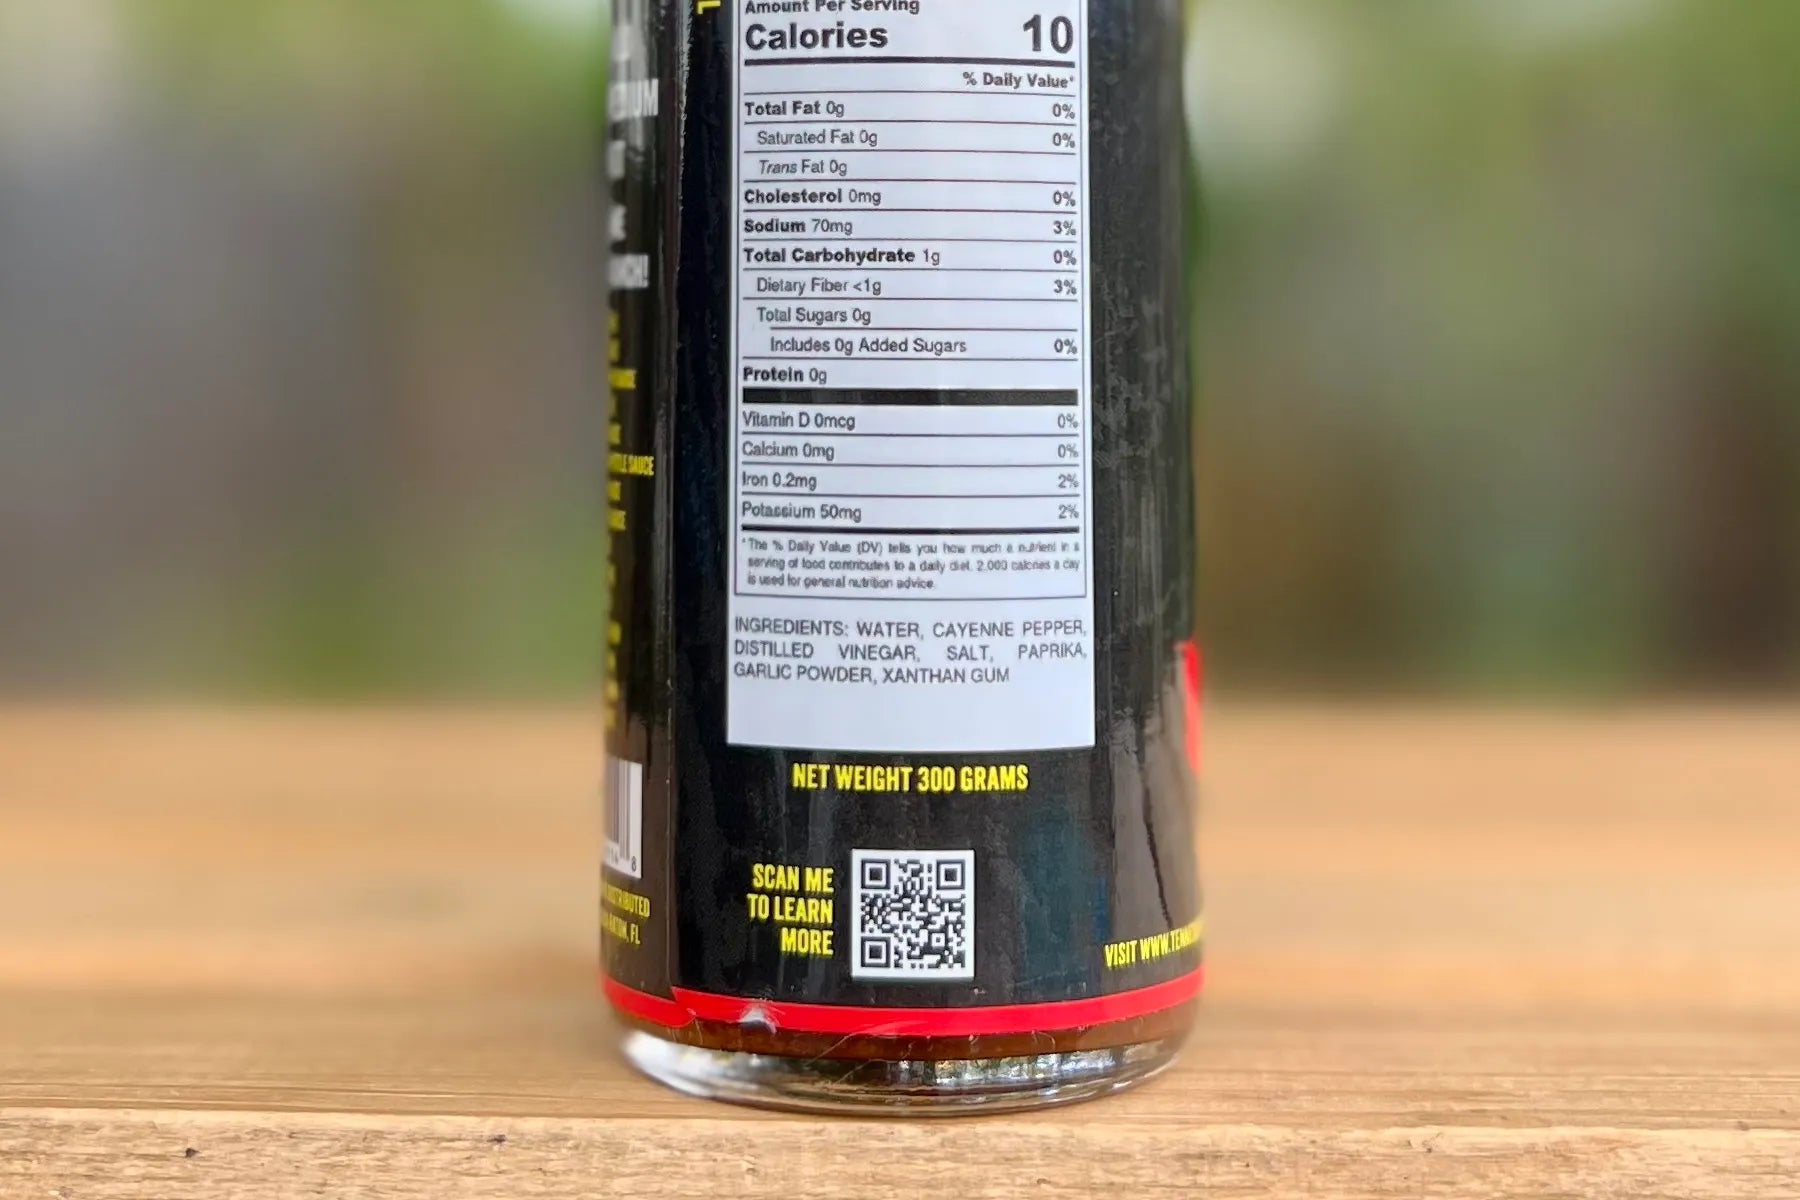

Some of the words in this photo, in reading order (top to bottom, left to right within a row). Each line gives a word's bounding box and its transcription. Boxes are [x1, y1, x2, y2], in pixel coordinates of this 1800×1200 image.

[745, 22, 888, 51] Calories
[1022, 14, 1074, 54] 10
[983, 73, 1022, 89] Daily
[745, 101, 787, 116] Total
[792, 101, 821, 115] Fat
[826, 101, 845, 118] 0g
[1052, 104, 1075, 119] 0%
[757, 130, 826, 145] Saturated
[830, 131, 855, 144] Fat
[860, 131, 877, 147] 0g
[1052, 133, 1075, 148] 0%
[759, 160, 797, 174] Trans
[801, 160, 825, 174] Fat
[829, 160, 848, 176] 0g
[744, 188, 843, 204] Cholesterol
[848, 189, 882, 205] 0mg
[1053, 191, 1076, 207] 0%
[744, 218, 806, 233] Sodium
[811, 219, 852, 235] 70mg
[1053, 221, 1076, 236] 3%
[744, 248, 785, 263] Total
[792, 248, 915, 267] Carbohydrate
[923, 249, 940, 265] 1g
[1054, 251, 1076, 265] 0%
[757, 278, 806, 296] Dietary
[811, 278, 848, 292] Fiber
[852, 278, 882, 295] <1g
[1054, 280, 1076, 294] 3%
[757, 308, 792, 322] Total
[795, 308, 848, 326] Sugars
[852, 309, 871, 325] 0g
[770, 337, 830, 352] Includes
[835, 338, 852, 354] 0g
[858, 337, 908, 352] Added
[913, 338, 967, 356] Sugars
[1054, 338, 1077, 354] 0%
[743, 367, 803, 382] Protein
[809, 368, 827, 384] 0g
[743, 411, 794, 427] Vitamin
[799, 413, 810, 427] D
[814, 413, 855, 430] 0mcg
[1057, 413, 1079, 429] 0%
[743, 441, 798, 458] Calcium
[803, 442, 835, 461] 0mg
[1057, 443, 1079, 458] 0%
[743, 471, 768, 487] Iron
[772, 472, 817, 490] 0.2mg
[1058, 474, 1079, 488] 2%
[743, 502, 816, 519] Potassium
[820, 504, 861, 522] 50mg
[1058, 504, 1079, 519] 2%
[788, 540, 814, 554] Daily
[820, 540, 851, 552] Value
[857, 541, 882, 555] (DV)
[888, 542, 911, 553] tells
[916, 544, 937, 555] you
[943, 542, 965, 553] how
[972, 543, 1001, 553] much
[748, 557, 785, 570] serving
[788, 558, 798, 568] of
[802, 558, 825, 569] food
[829, 559, 889, 570] contributes
[895, 560, 904, 571] to
[920, 561, 945, 573] daily
[748, 575, 756, 584] is
[759, 574, 784, 585] used
[788, 575, 800, 585] for
[804, 576, 845, 588] general
[849, 577, 893, 588] nutrition
[735, 617, 848, 636] INGREDIENTS:
[857, 622, 924, 639] WATER,
[933, 622, 1014, 637] CAYENNE
[1023, 620, 1086, 636] PEPPER,
[735, 641, 814, 658] DISTILLED
[839, 645, 920, 661] VINEGAR,
[947, 645, 993, 661] SALT,
[1018, 643, 1086, 660] PAPRIKA,
[734, 664, 792, 680] GARLIC
[797, 666, 877, 684] POWDER,
[883, 668, 965, 683] XANTHAN
[971, 667, 1009, 682] GUM
[792, 763, 830, 789] NET
[836, 765, 912, 792] WEIGHT
[917, 766, 955, 792] 300
[961, 765, 1028, 792] GRAMS
[753, 864, 799, 890] SCAN
[806, 867, 833, 892] ME
[747, 894, 769, 920] TO
[775, 896, 833, 923] LEARN
[781, 928, 833, 955] MORE
[1105, 940, 1137, 968] VISIT
